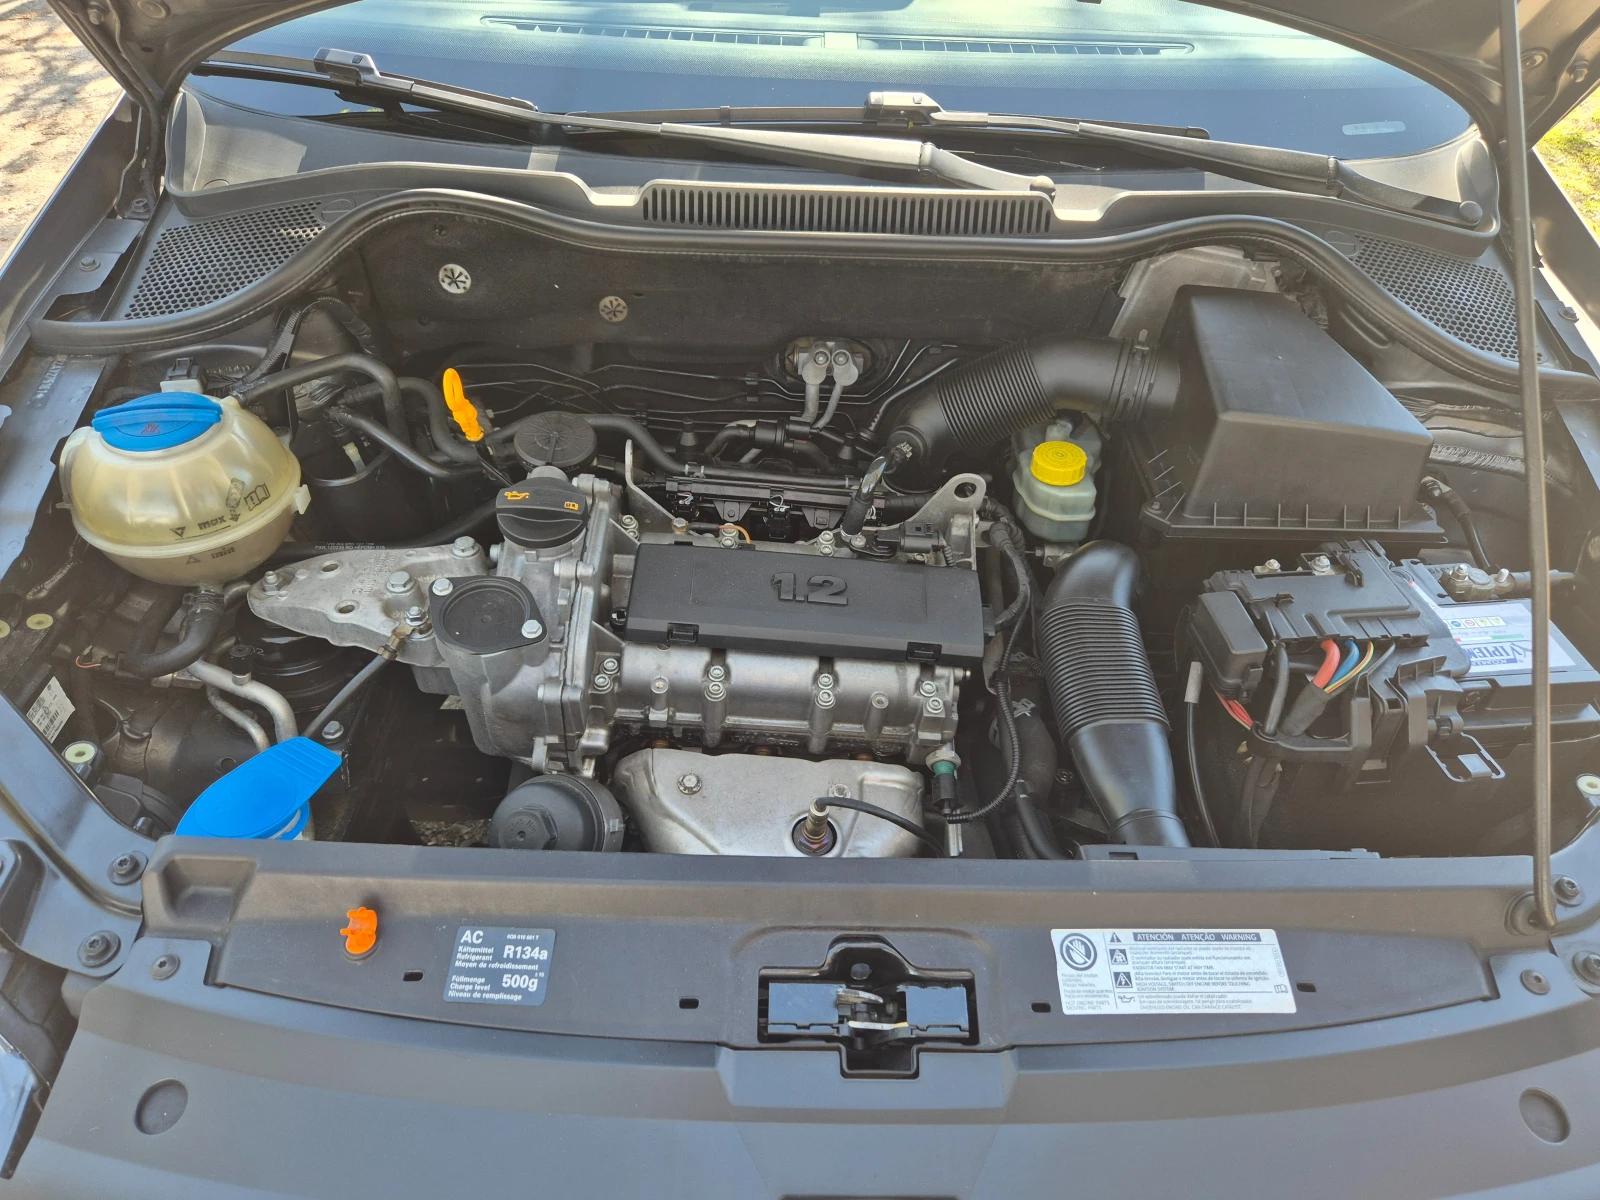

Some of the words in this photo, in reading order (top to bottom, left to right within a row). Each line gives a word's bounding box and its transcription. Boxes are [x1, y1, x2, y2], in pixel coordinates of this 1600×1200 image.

[198, 515, 226, 530] max
[211, 546, 235, 560] min
[770, 572, 848, 606] 1.2
[460, 930, 484, 944] AC
[1137, 932, 1174, 941] ATENCIÓN
[1181, 932, 1215, 942] ATENÇÃO
[1221, 933, 1257, 941] WARNING
[456, 953, 492, 961] Refrigerant
[503, 945, 548, 960] R134a
[452, 975, 485, 983] Füllmenge
[502, 974, 538, 992] 500g
[482, 992, 522, 1001] remplissage
